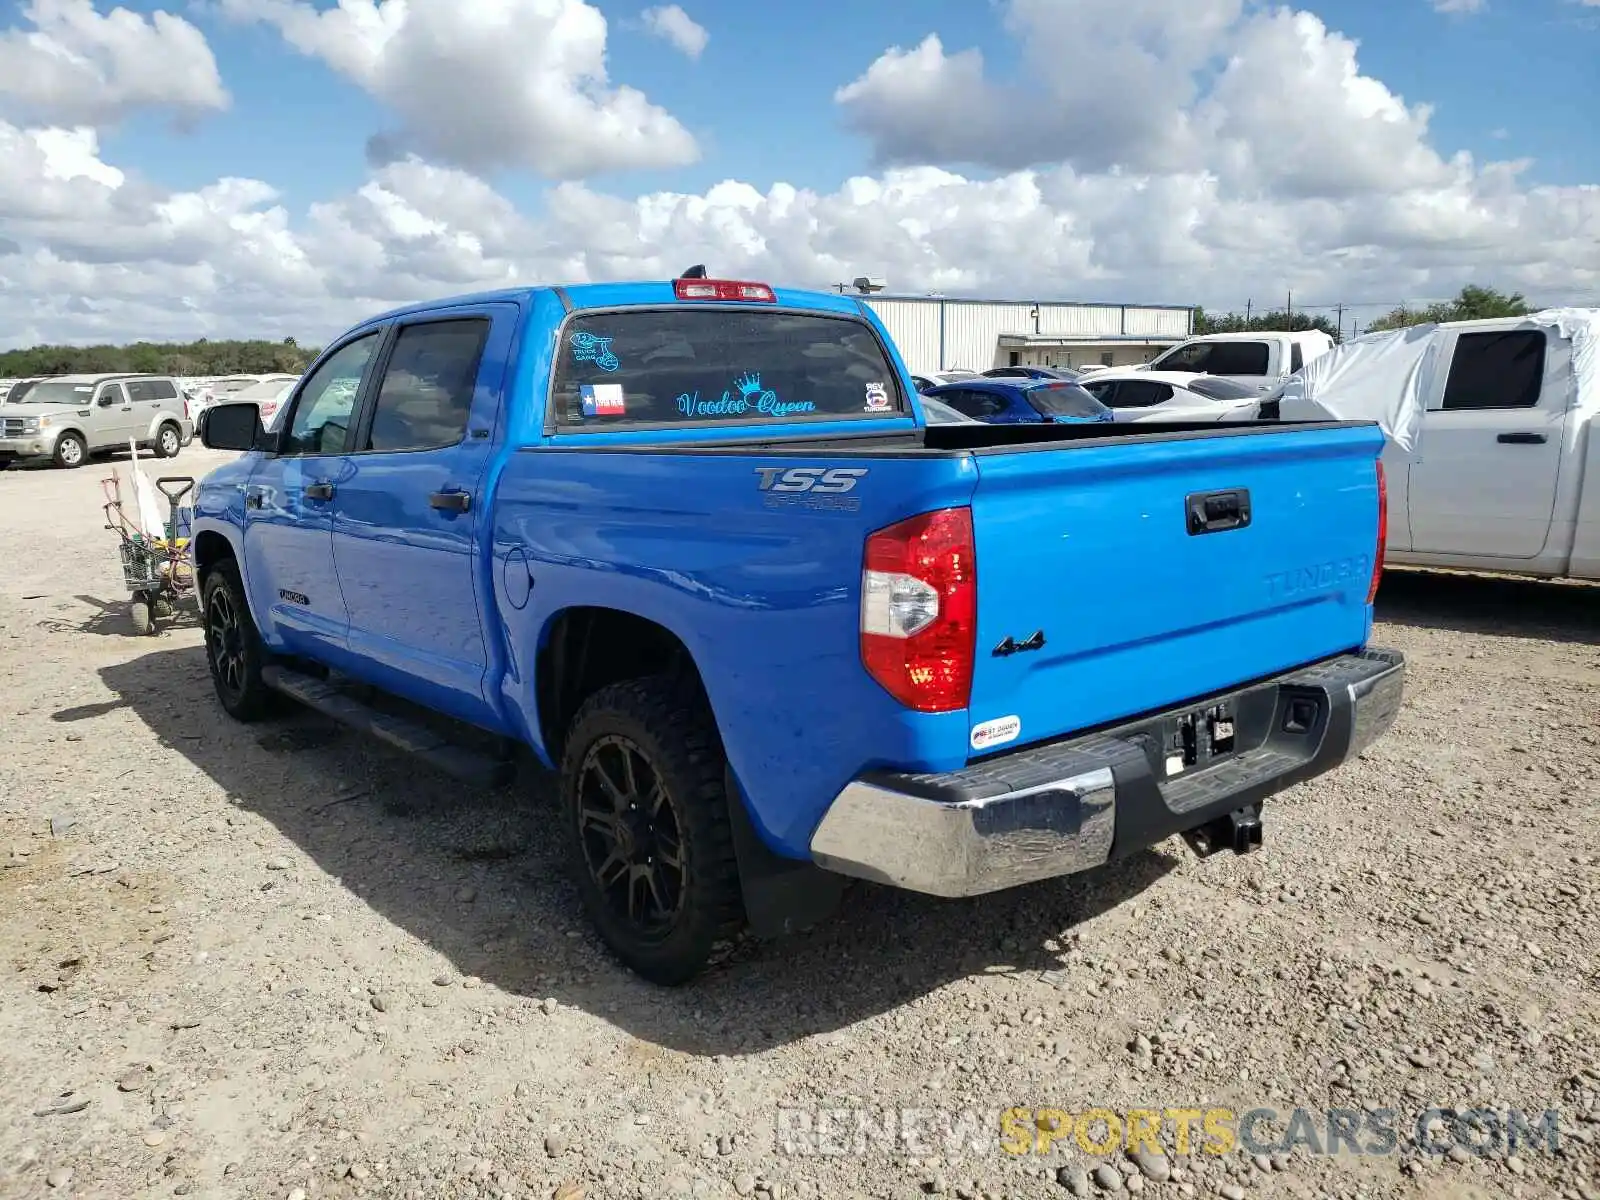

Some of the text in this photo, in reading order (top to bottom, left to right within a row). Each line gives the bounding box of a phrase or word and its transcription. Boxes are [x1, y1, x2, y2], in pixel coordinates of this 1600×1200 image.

[676, 390, 816, 416] Voodoo Queen
[754, 467, 869, 493] TSS
[991, 630, 1045, 657] 4x4
